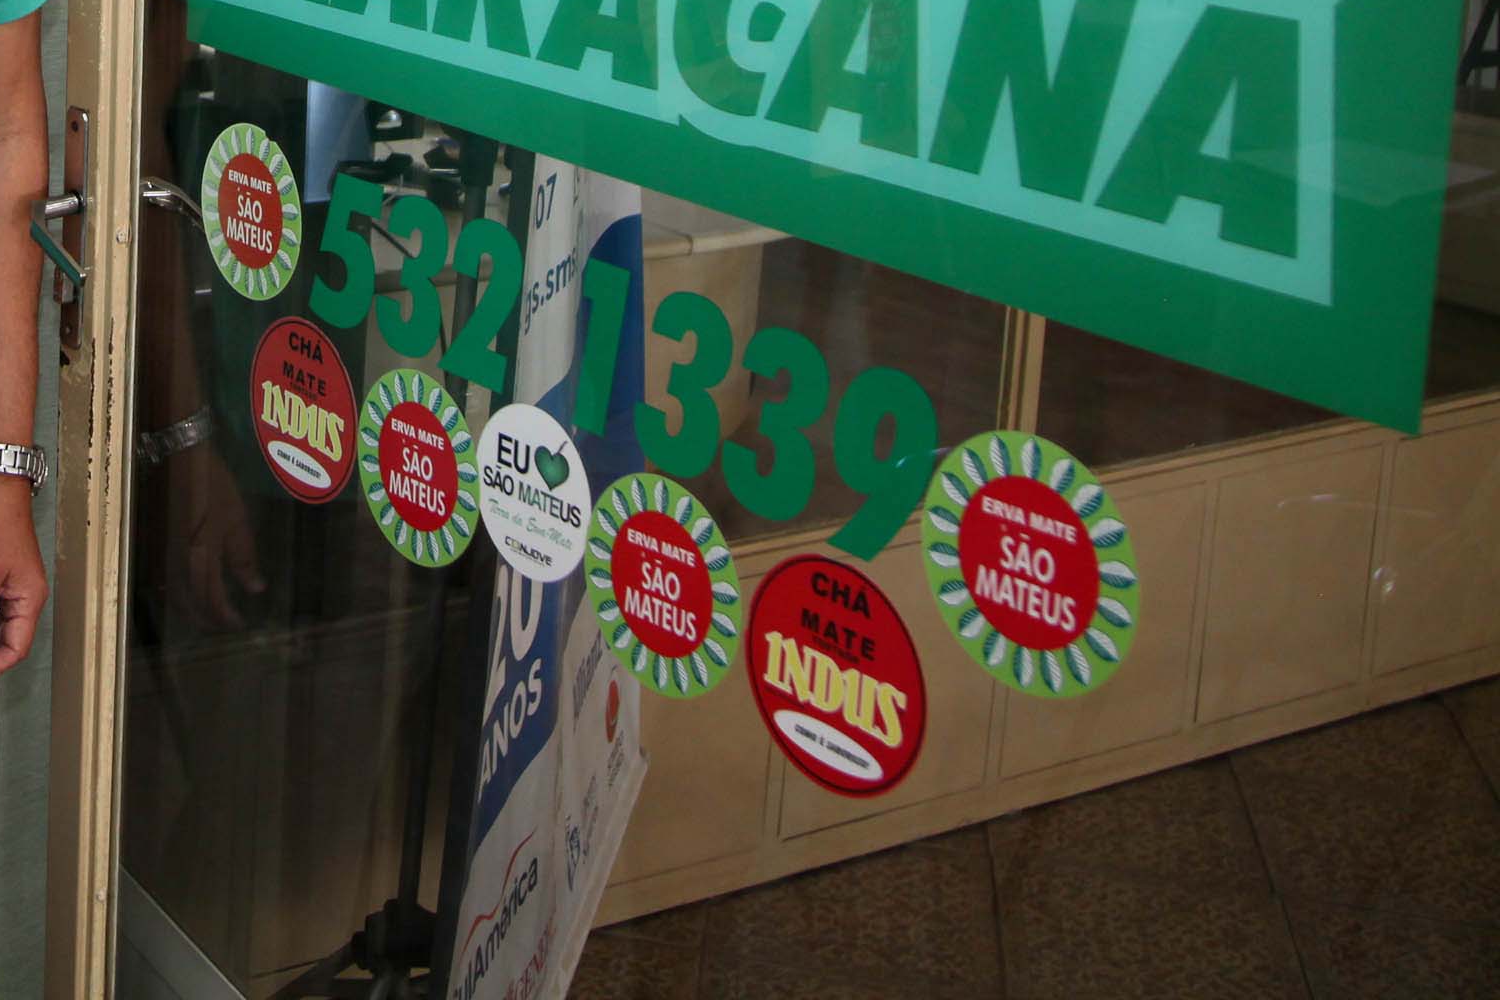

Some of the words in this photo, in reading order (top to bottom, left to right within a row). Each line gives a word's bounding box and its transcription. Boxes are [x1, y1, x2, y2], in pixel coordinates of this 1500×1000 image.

[228, 169, 249, 187] ERVA
[250, 177, 272, 194] MATE
[237, 192, 262, 223] SÃO
[226, 216, 273, 254] MATEUS
[288, 331, 323, 364] CHÁ
[308, 172, 523, 395] 532
[573, 257, 938, 561] 1339
[282, 360, 326, 396] MATE
[261, 380, 344, 462] INDUS
[391, 418, 416, 439] ERVA
[418, 428, 444, 451] MATE
[403, 444, 433, 482] SÃO
[497, 431, 530, 474] EU
[389, 469, 446, 516] MATEUS
[483, 465, 514, 496] SÃO
[518, 481, 581, 528] MATEUS
[981, 495, 1026, 526] ERVA
[1029, 511, 1078, 544] MATE
[627, 528, 659, 553] ERVA
[661, 541, 696, 568] MATE
[1000, 532, 1056, 584] SÃO
[642, 559, 681, 601] SÃO
[810, 571, 871, 620] CHÁ
[975, 563, 1077, 633] MATEUS
[624, 586, 697, 642] MATEUS
[801, 607, 876, 662] MATE
[763, 631, 908, 748] INDUS
[477, 657, 543, 804] ANOS
